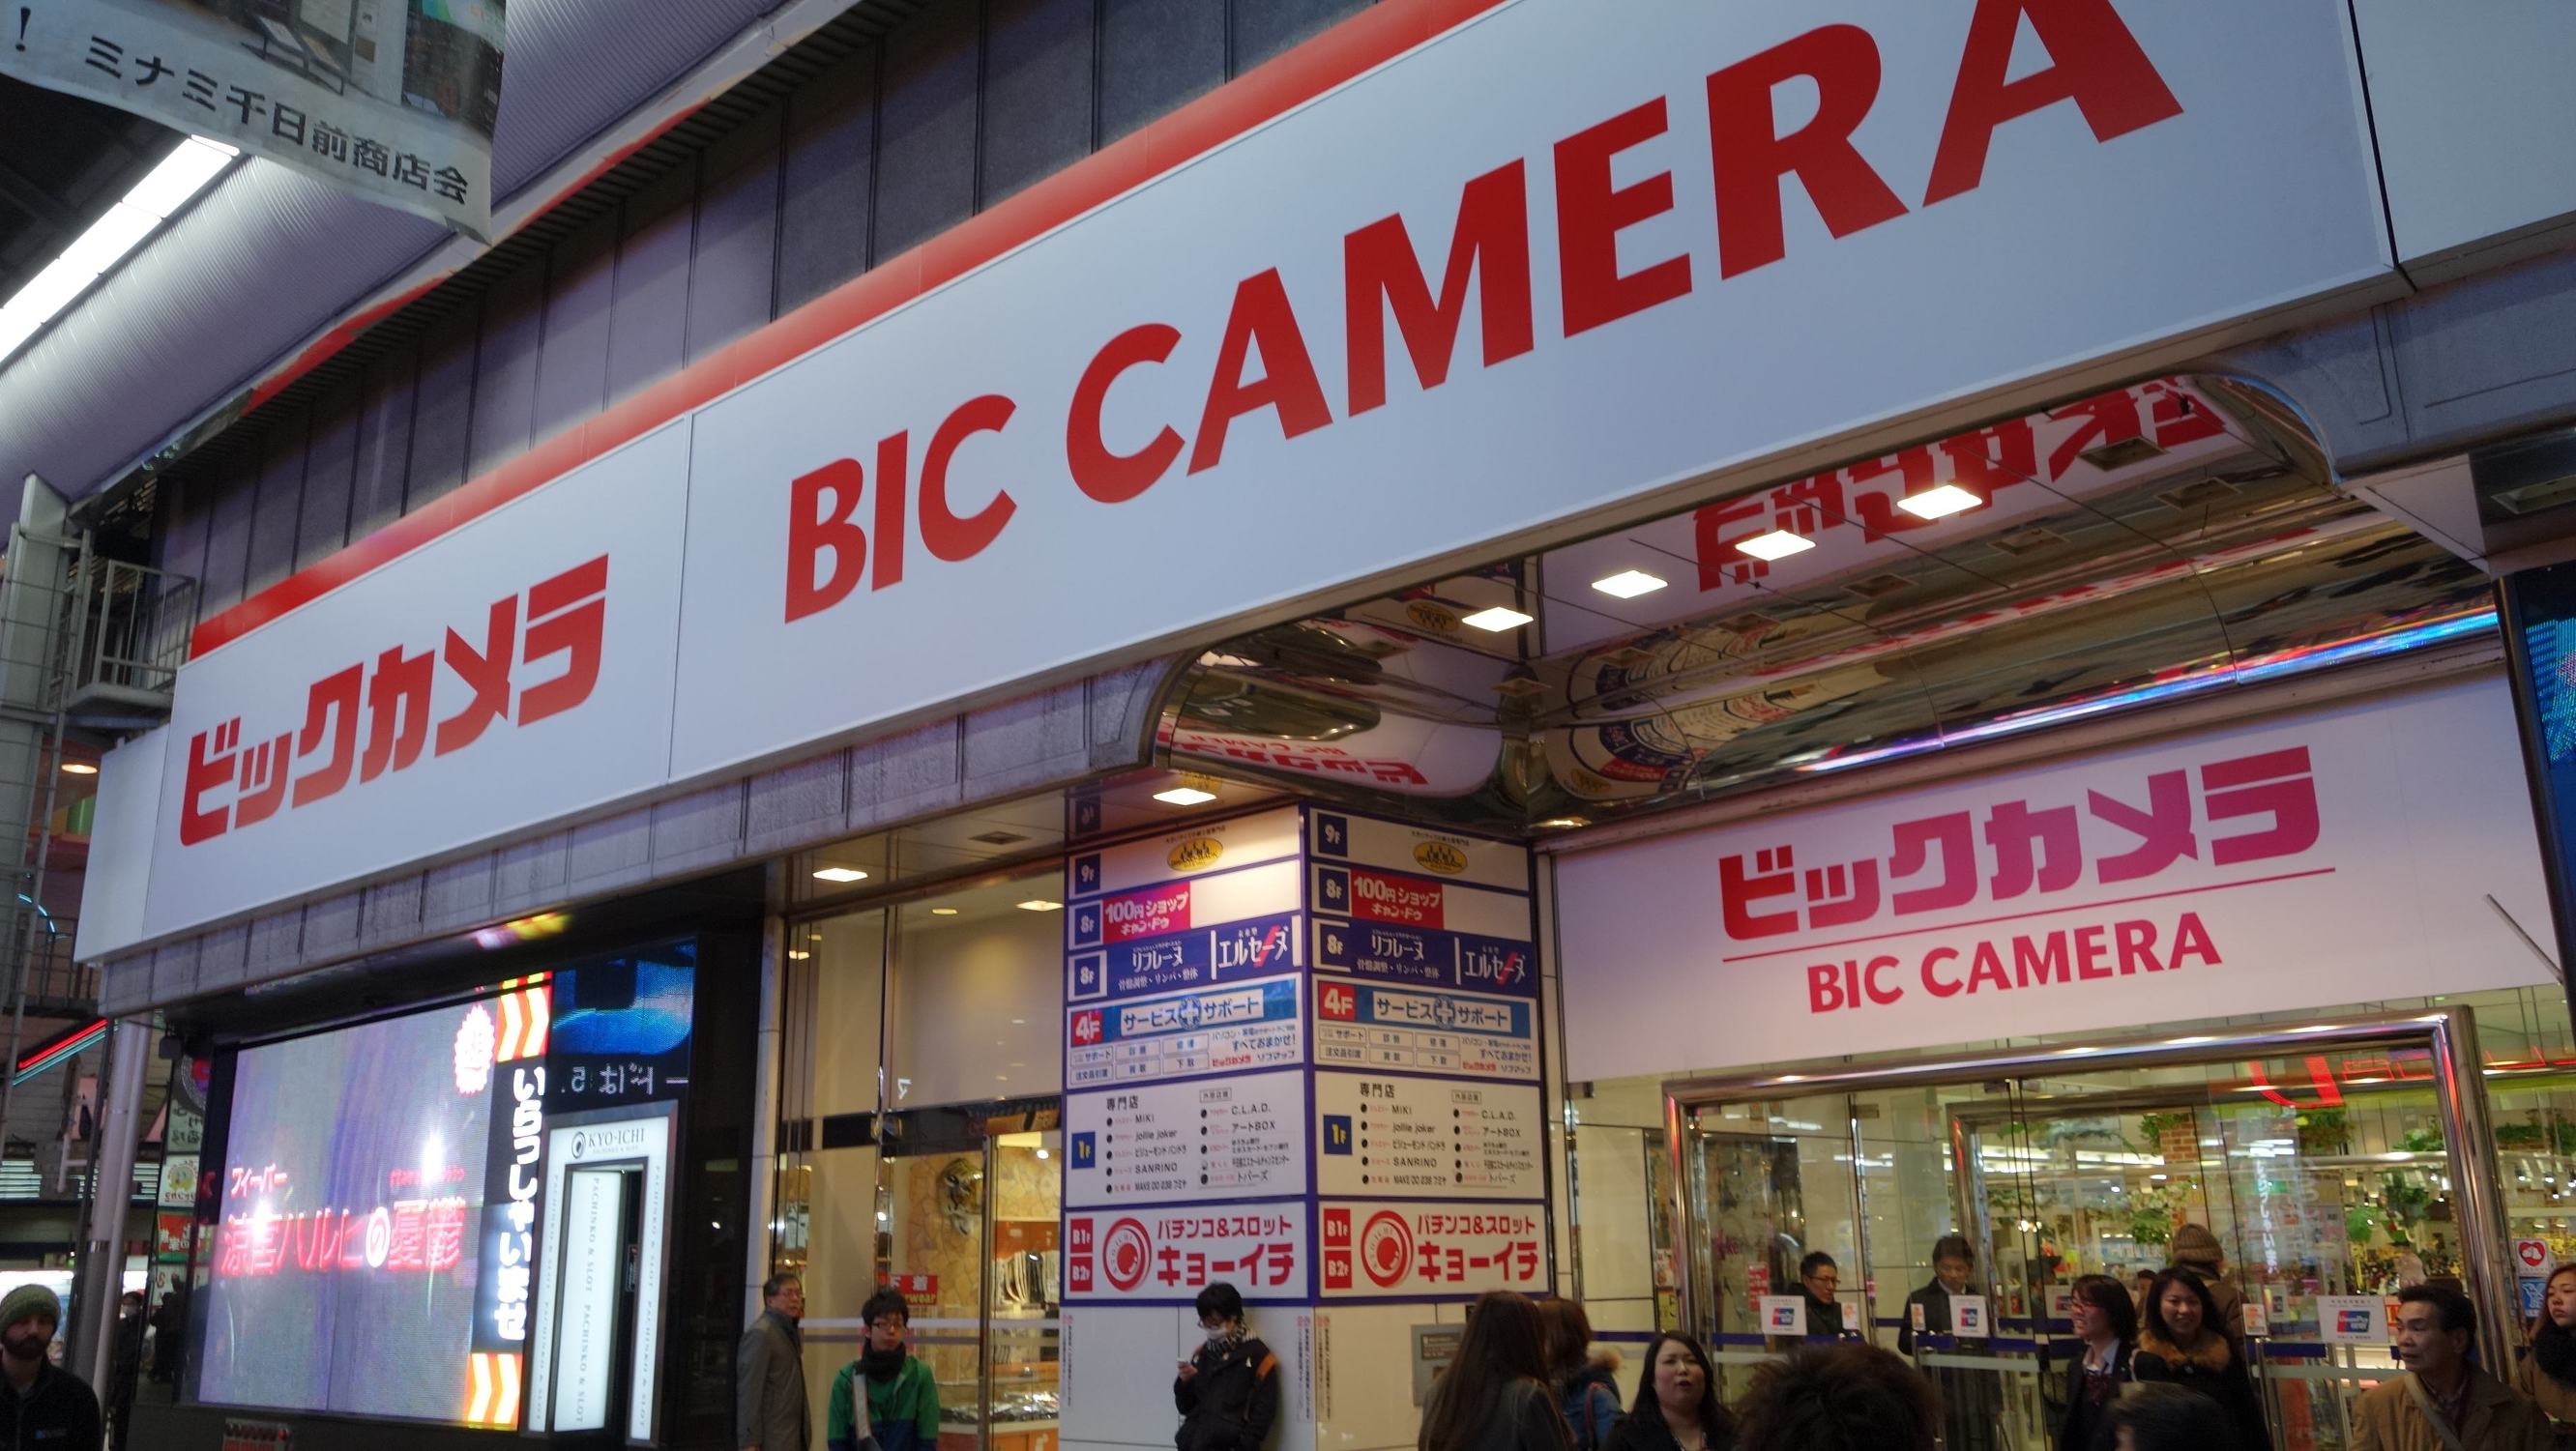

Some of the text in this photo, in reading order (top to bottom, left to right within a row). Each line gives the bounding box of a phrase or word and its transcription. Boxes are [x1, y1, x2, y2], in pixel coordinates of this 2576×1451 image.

[85, 36, 469, 206] ミナミ千日前商店会
[785, 0, 2184, 624] BIC CAMERA
[180, 553, 609, 846] ビックカメラ
[1324, 824, 1341, 845] 9F
[1718, 745, 2321, 941] ビックカメラ
[1080, 864, 1095, 883] 9F
[1326, 878, 1342, 900] 8F
[1080, 914, 1095, 934] 8F
[1218, 925, 1290, 969] エルセーヌ
[1327, 934, 1344, 956] 8F
[1371, 934, 1425, 962] リフレーヌ
[1132, 945, 1184, 973] リフレーヌ
[1464, 948, 1527, 986] エルセーヌ
[1807, 913, 2223, 1013] BIC CAMERA
[1080, 965, 1095, 985] 8F
[1324, 987, 1354, 1016] 4F
[1376, 998, 1509, 1028] サービス サポート
[1124, 997, 1259, 1031] サービス サポート
[1074, 1014, 1102, 1041] 4F
[1359, 1082, 1395, 1099] 専門店
[1106, 1095, 1139, 1112] 専門店
[1391, 1104, 1413, 1116] MIKI
[1134, 1114, 1156, 1124] MIKI
[1231, 1120, 1276, 1134] アートBOX
[1331, 1122, 1347, 1146] 1F
[1483, 1126, 1522, 1138] アートBOX
[1077, 1140, 1092, 1160] 1F
[492, 1066, 546, 1341] いらっしゃいませ
[1157, 1215, 1293, 1240] パチンコ&スロット
[1327, 1220, 1349, 1237] B1F
[1418, 1214, 1536, 1235] パチンコ&スロット
[1072, 1229, 1091, 1245] B1F
[1071, 1264, 1091, 1282] B2F
[1157, 1243, 1294, 1287] キョーイチ
[1328, 1260, 1349, 1277] B2F
[1418, 1240, 1538, 1283] キョーイチ
